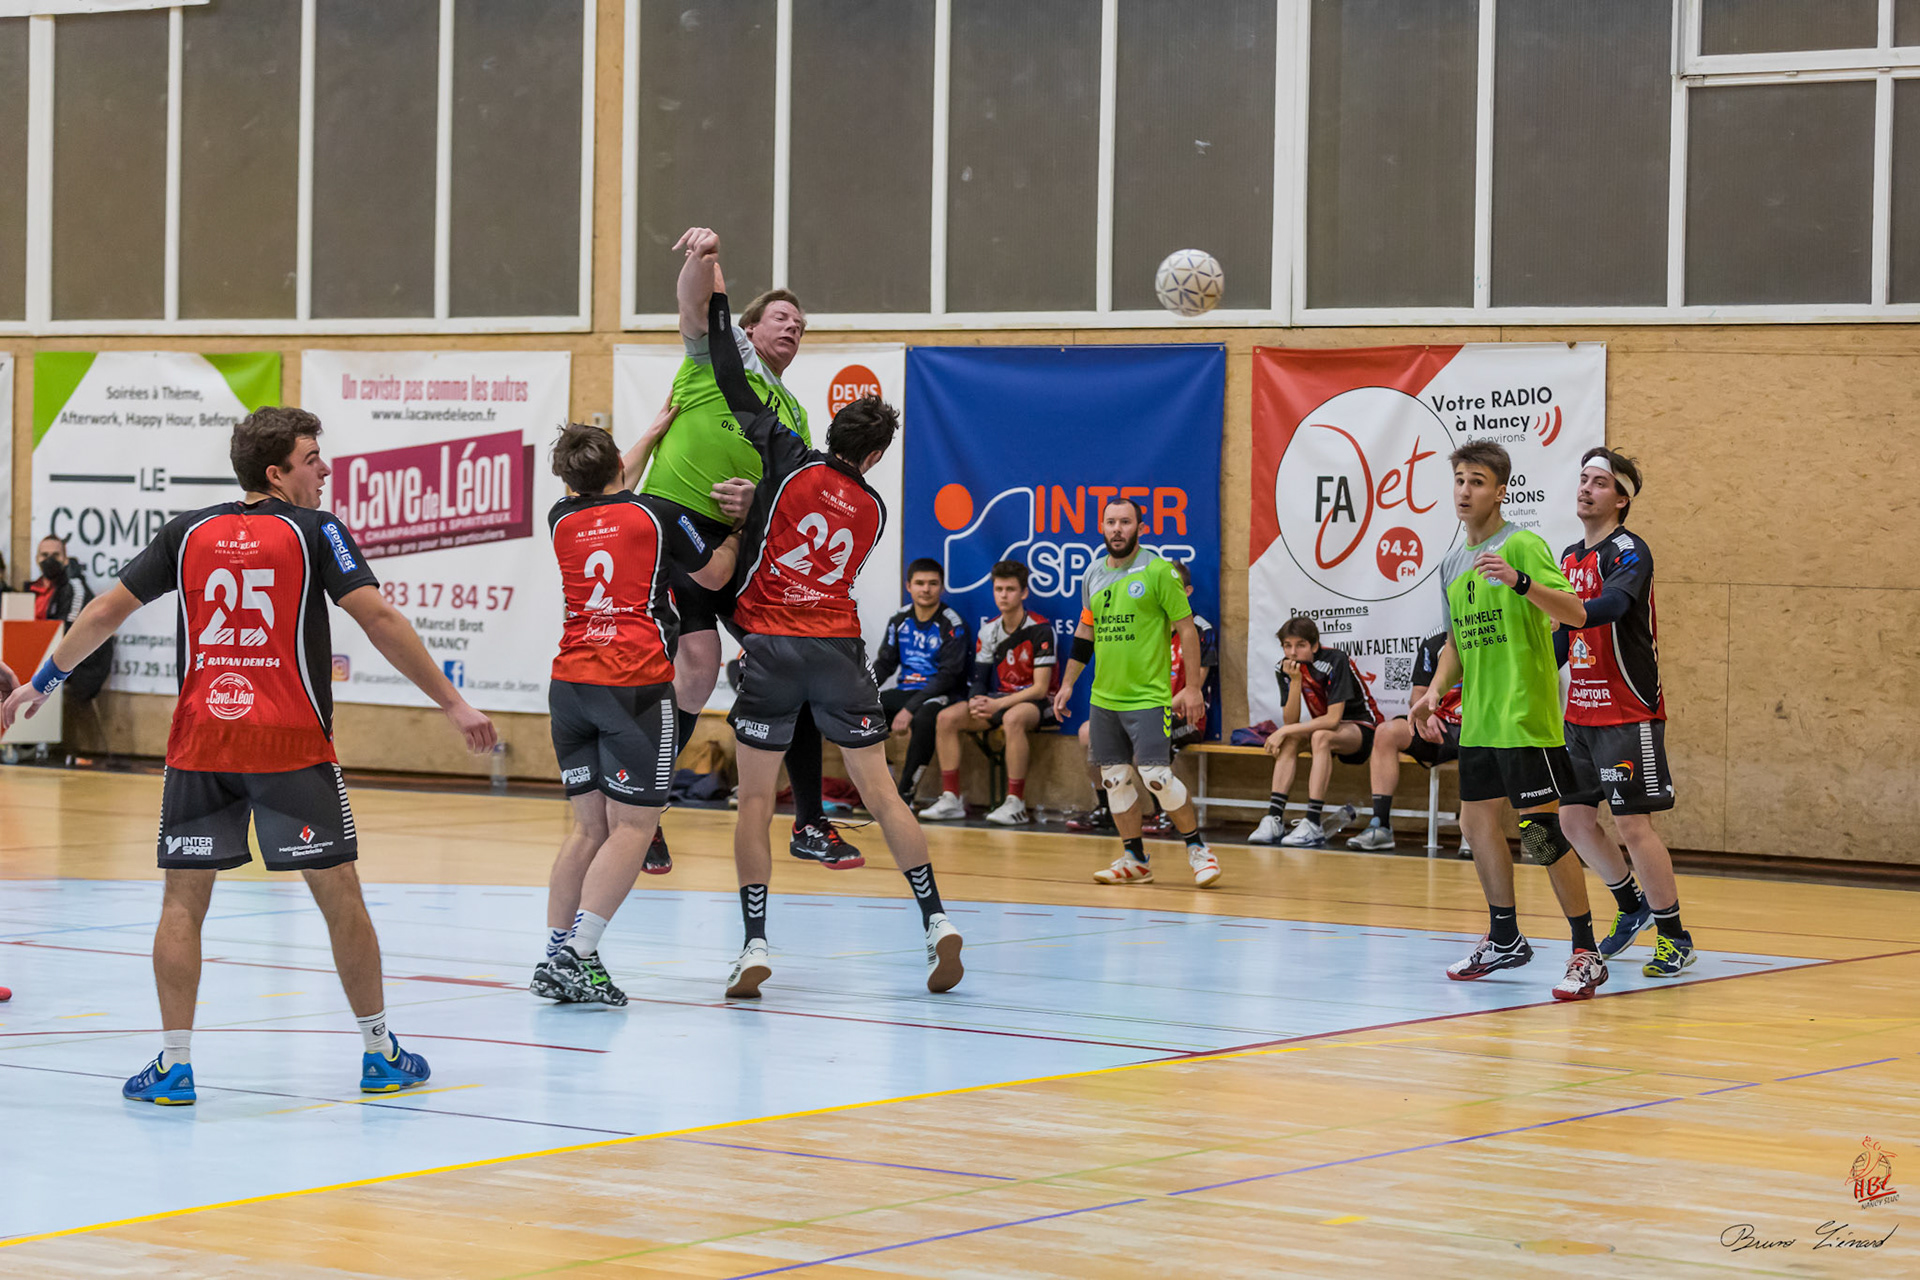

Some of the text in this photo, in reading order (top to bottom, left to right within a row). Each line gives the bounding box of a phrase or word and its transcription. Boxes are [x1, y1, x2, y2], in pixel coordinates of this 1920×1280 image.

[106, 385, 149, 400] Soirées
[342, 374, 528, 404] Un caviste pas comme les autres
[1431, 386, 1553, 413] Votre RADIO
[60, 412, 122, 427] Afterwork,
[126, 413, 162, 428] Happy
[166, 413, 196, 427] Hour,
[371, 408, 497, 422] www.lacavedeleon.fr
[721, 420, 735, 432] 06
[1455, 413, 1531, 434] à Nancy
[140, 468, 166, 492] LE
[349, 457, 422, 531] Cave
[422, 486, 439, 521] de
[440, 441, 511, 518] Léon
[1502, 490, 1545, 505] SIONS
[1508, 508, 1538, 518] culture,
[50, 507, 186, 546] COMP
[365, 523, 438, 542] CHAMPAGNES
[449, 512, 511, 530] SPIRITUEUX
[216, 540, 260, 550] AU BUREAU
[1379, 540, 1418, 557] 94.2
[1027, 541, 1196, 598] SPT
[1400, 564, 1416, 577] FM
[583, 550, 614, 612] 2
[382, 581, 515, 611] 83 17 84 57
[1104, 589, 1111, 608] 2
[1467, 580, 1475, 604] 8
[199, 568, 275, 646] 25
[415, 617, 484, 633] Marcel Brot
[1322, 620, 1352, 633] Infos
[428, 637, 470, 651] NANCY
[1482, 637, 1494, 646] 56
[1496, 634, 1508, 644] 66
[207, 657, 280, 668] RAYAN DEM 54
[209, 689, 230, 705] Cave
[233, 689, 255, 705] Léon
[744, 728, 769, 740] SPORT
[745, 721, 770, 732] INTER
[569, 773, 591, 784] SPORT
[1527, 787, 1553, 798] PATRICK
[182, 837, 213, 846] INTER
[182, 847, 213, 856] SPORT
